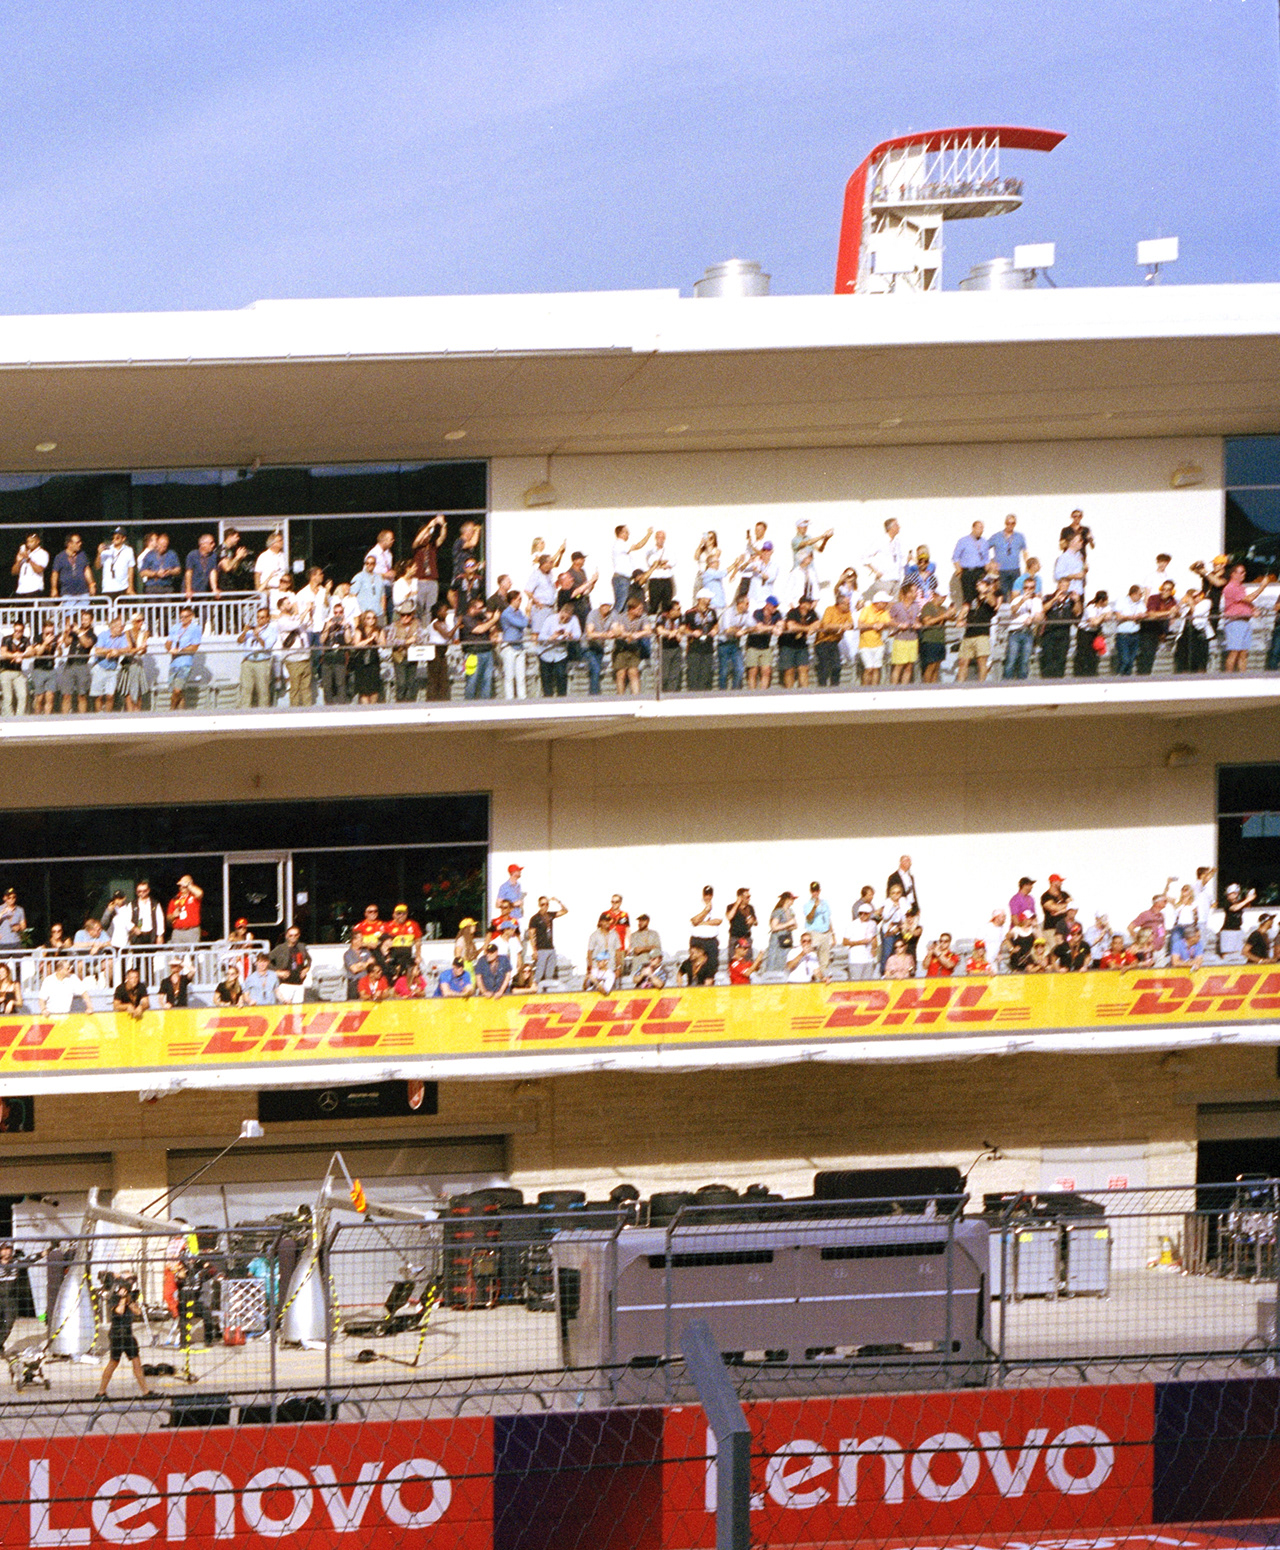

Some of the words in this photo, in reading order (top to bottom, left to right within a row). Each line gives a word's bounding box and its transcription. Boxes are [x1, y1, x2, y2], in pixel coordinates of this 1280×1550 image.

[516, 997, 692, 1041] DHL
[822, 985, 1000, 1026] DHL
[202, 1010, 383, 1055] DHL
[28, 1457, 453, 1549] Lenovo
